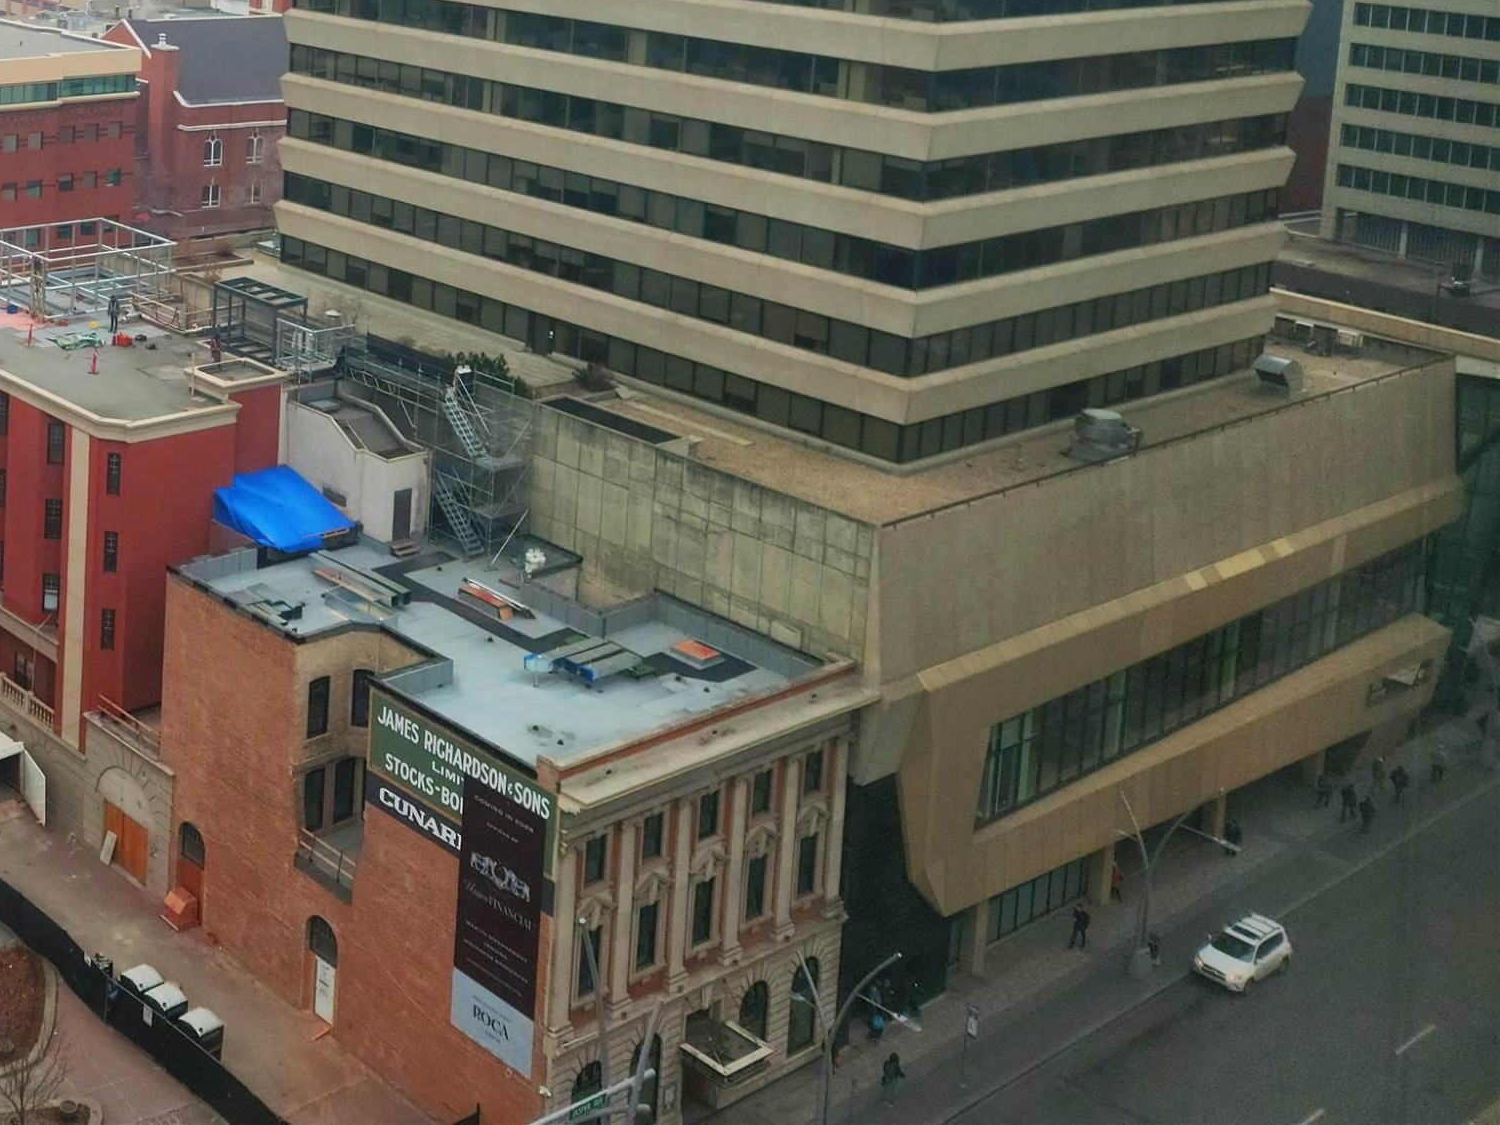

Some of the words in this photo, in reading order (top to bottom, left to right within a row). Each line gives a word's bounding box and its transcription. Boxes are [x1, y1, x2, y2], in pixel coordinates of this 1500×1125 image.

[377, 706, 420, 745] JAMES
[424, 729, 508, 796] RICHARDSON
[513, 781, 550, 820] SONS
[473, 1004, 509, 1041] ROCA
